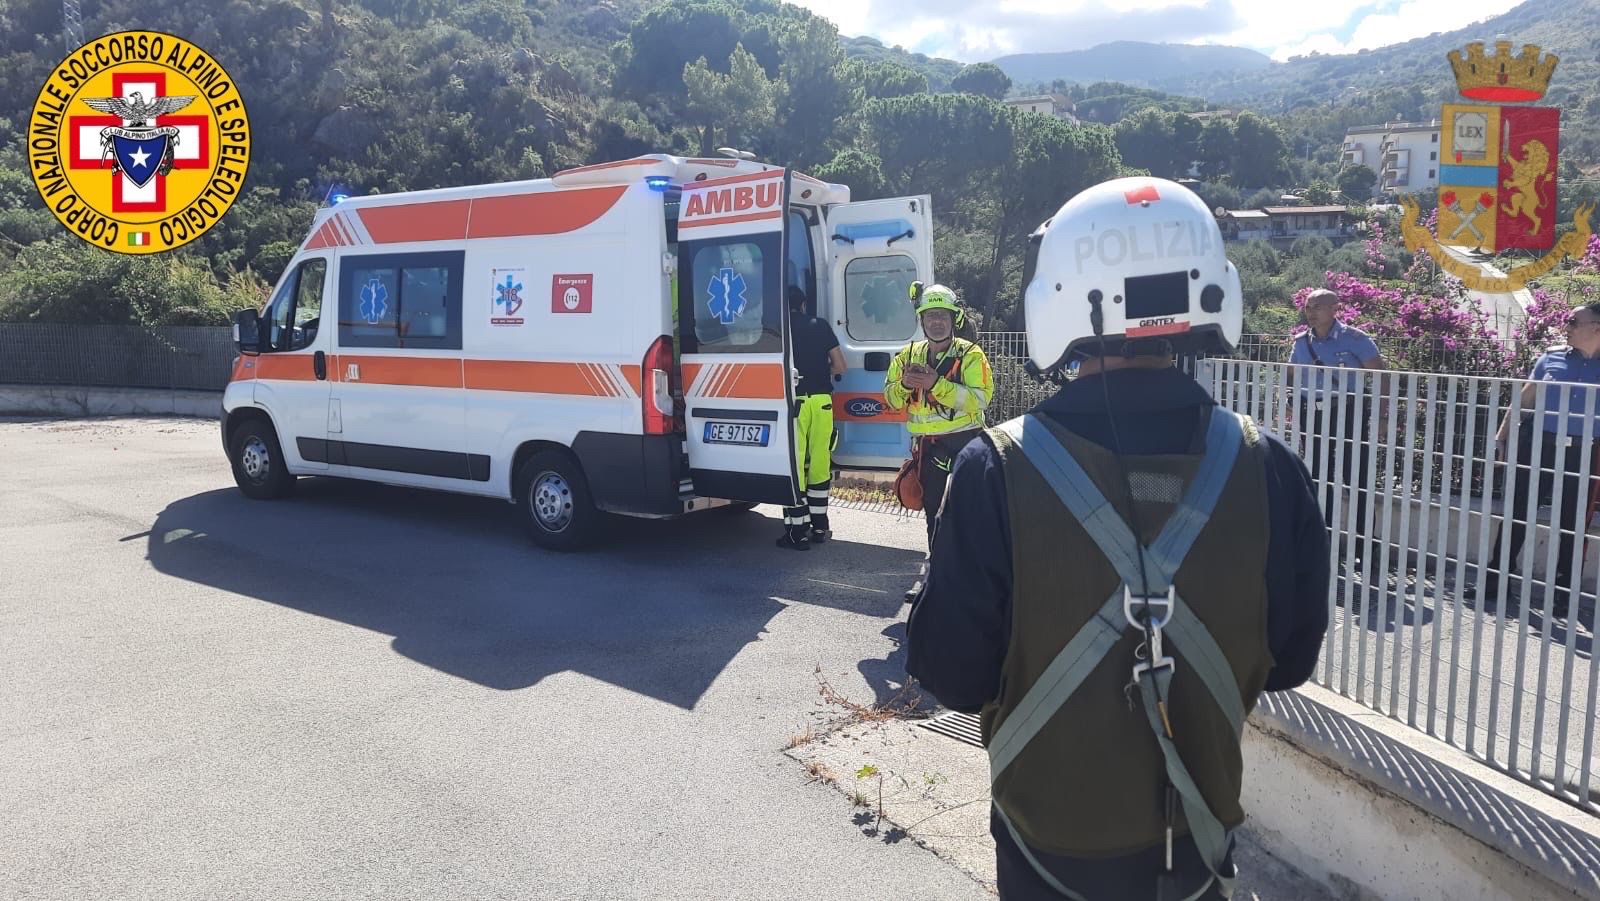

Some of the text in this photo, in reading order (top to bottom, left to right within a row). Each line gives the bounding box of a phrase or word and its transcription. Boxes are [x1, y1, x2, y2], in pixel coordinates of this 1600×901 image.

[685, 181, 784, 217] AMBU
[1075, 220, 1217, 274] POLIZIA
[1139, 317, 1176, 328] GENTEX
